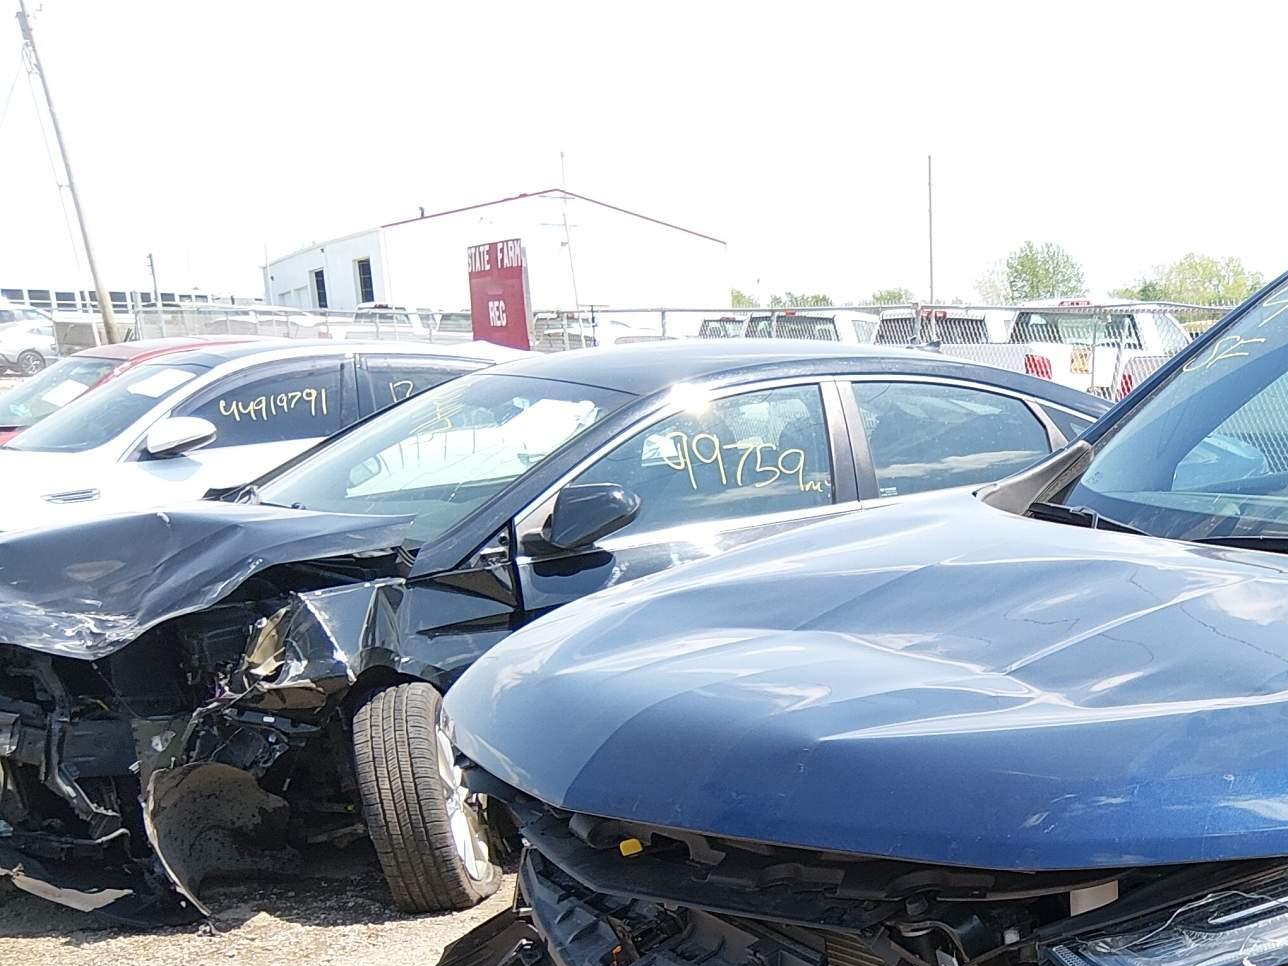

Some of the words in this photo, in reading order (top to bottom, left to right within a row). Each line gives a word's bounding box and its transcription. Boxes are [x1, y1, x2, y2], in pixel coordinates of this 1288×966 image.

[468, 245, 491, 272] STATE
[497, 240, 522, 268] FARM
[219, 388, 328, 422] 44919791
